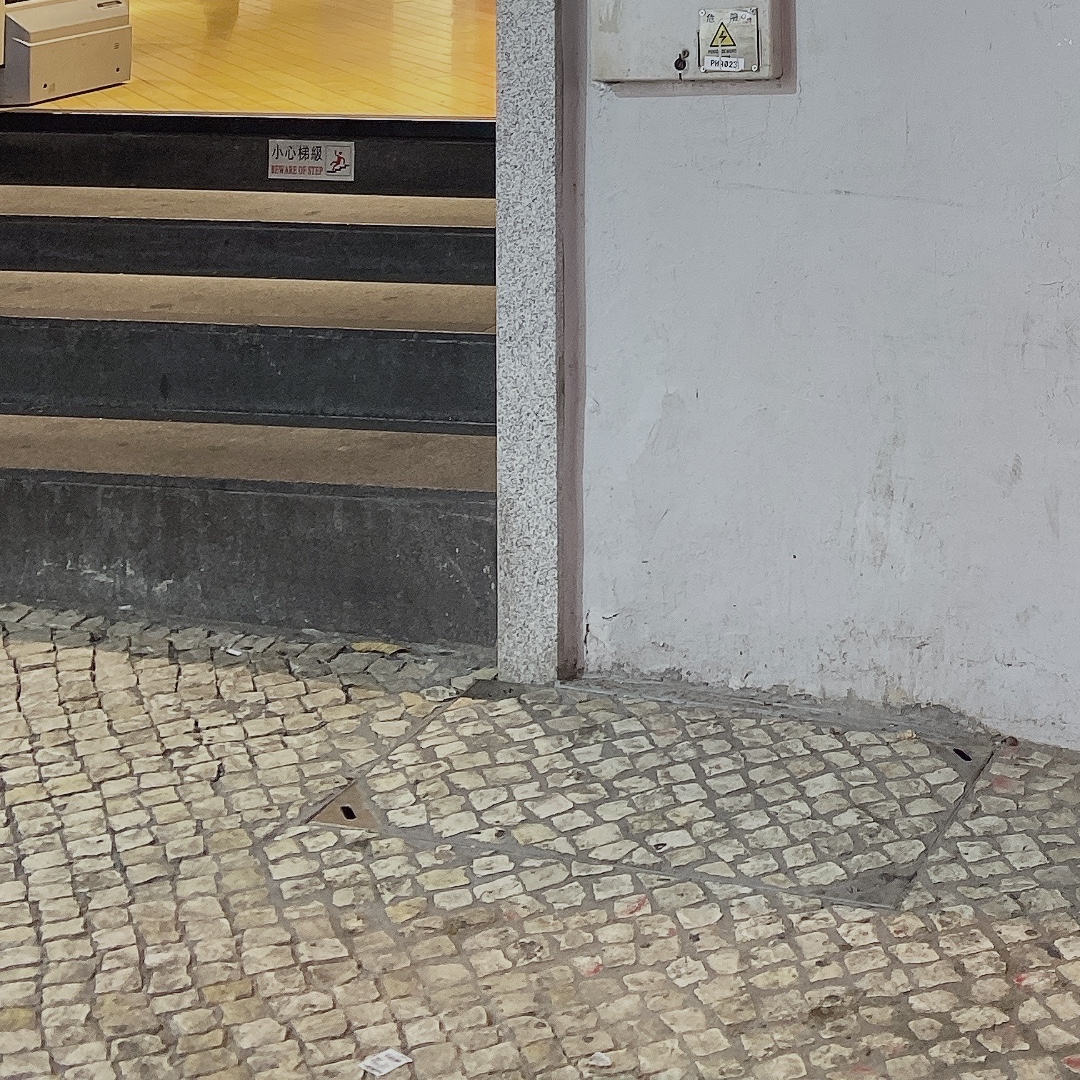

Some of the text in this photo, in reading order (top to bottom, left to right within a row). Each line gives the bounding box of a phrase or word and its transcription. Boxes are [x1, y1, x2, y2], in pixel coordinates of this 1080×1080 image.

[271, 143, 323, 161] 小心梯級
[307, 165, 324, 176] STEP
